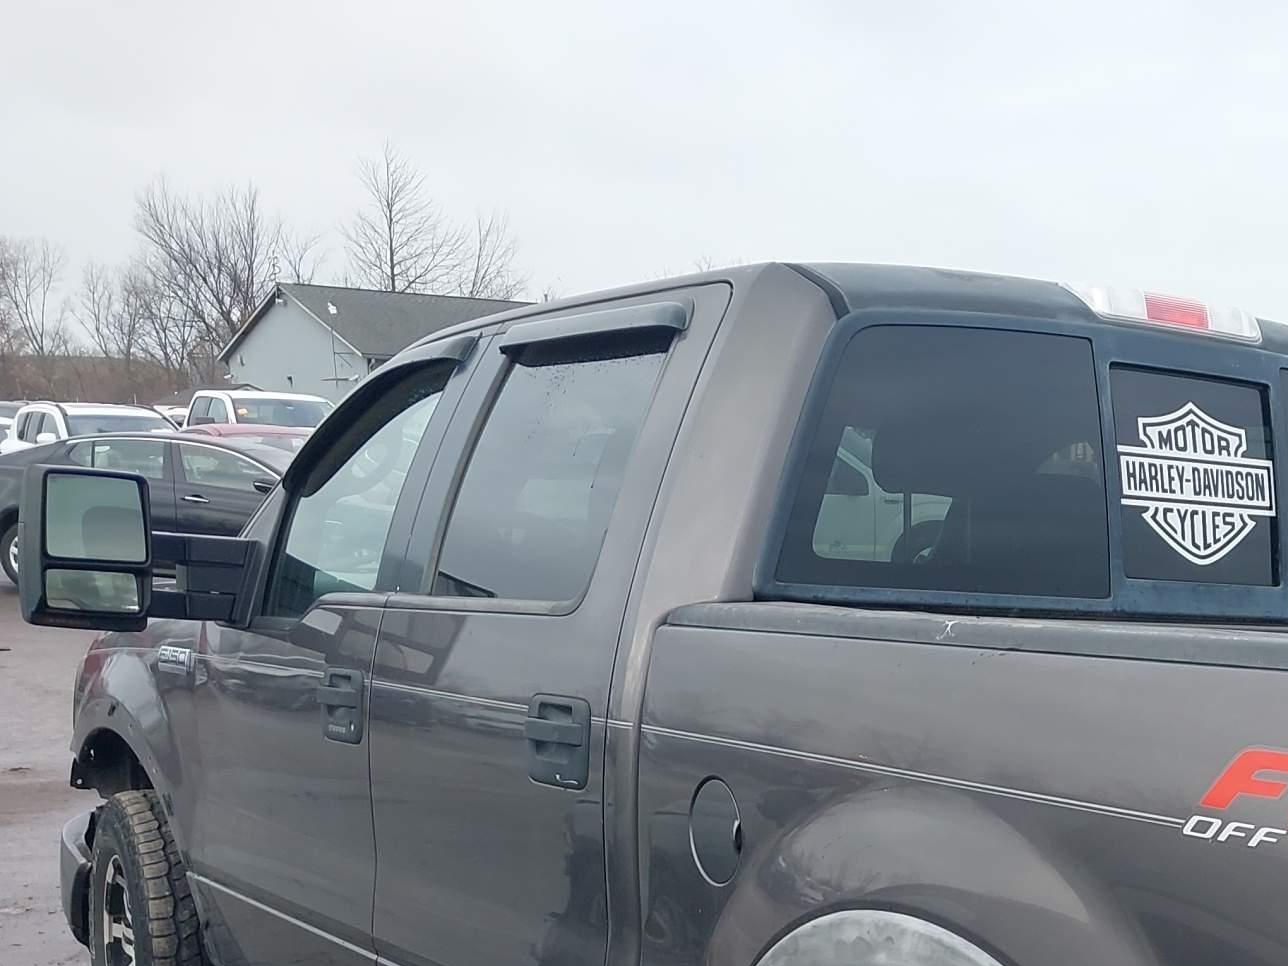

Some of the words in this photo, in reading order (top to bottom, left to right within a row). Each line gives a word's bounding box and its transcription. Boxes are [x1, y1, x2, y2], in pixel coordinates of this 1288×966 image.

[1157, 419, 1231, 457] MOTOR
[1126, 460, 1266, 502] HARLEY-DAVIDSON
[1163, 507, 1236, 551] CYCLES
[1182, 815, 1288, 847] OFF
